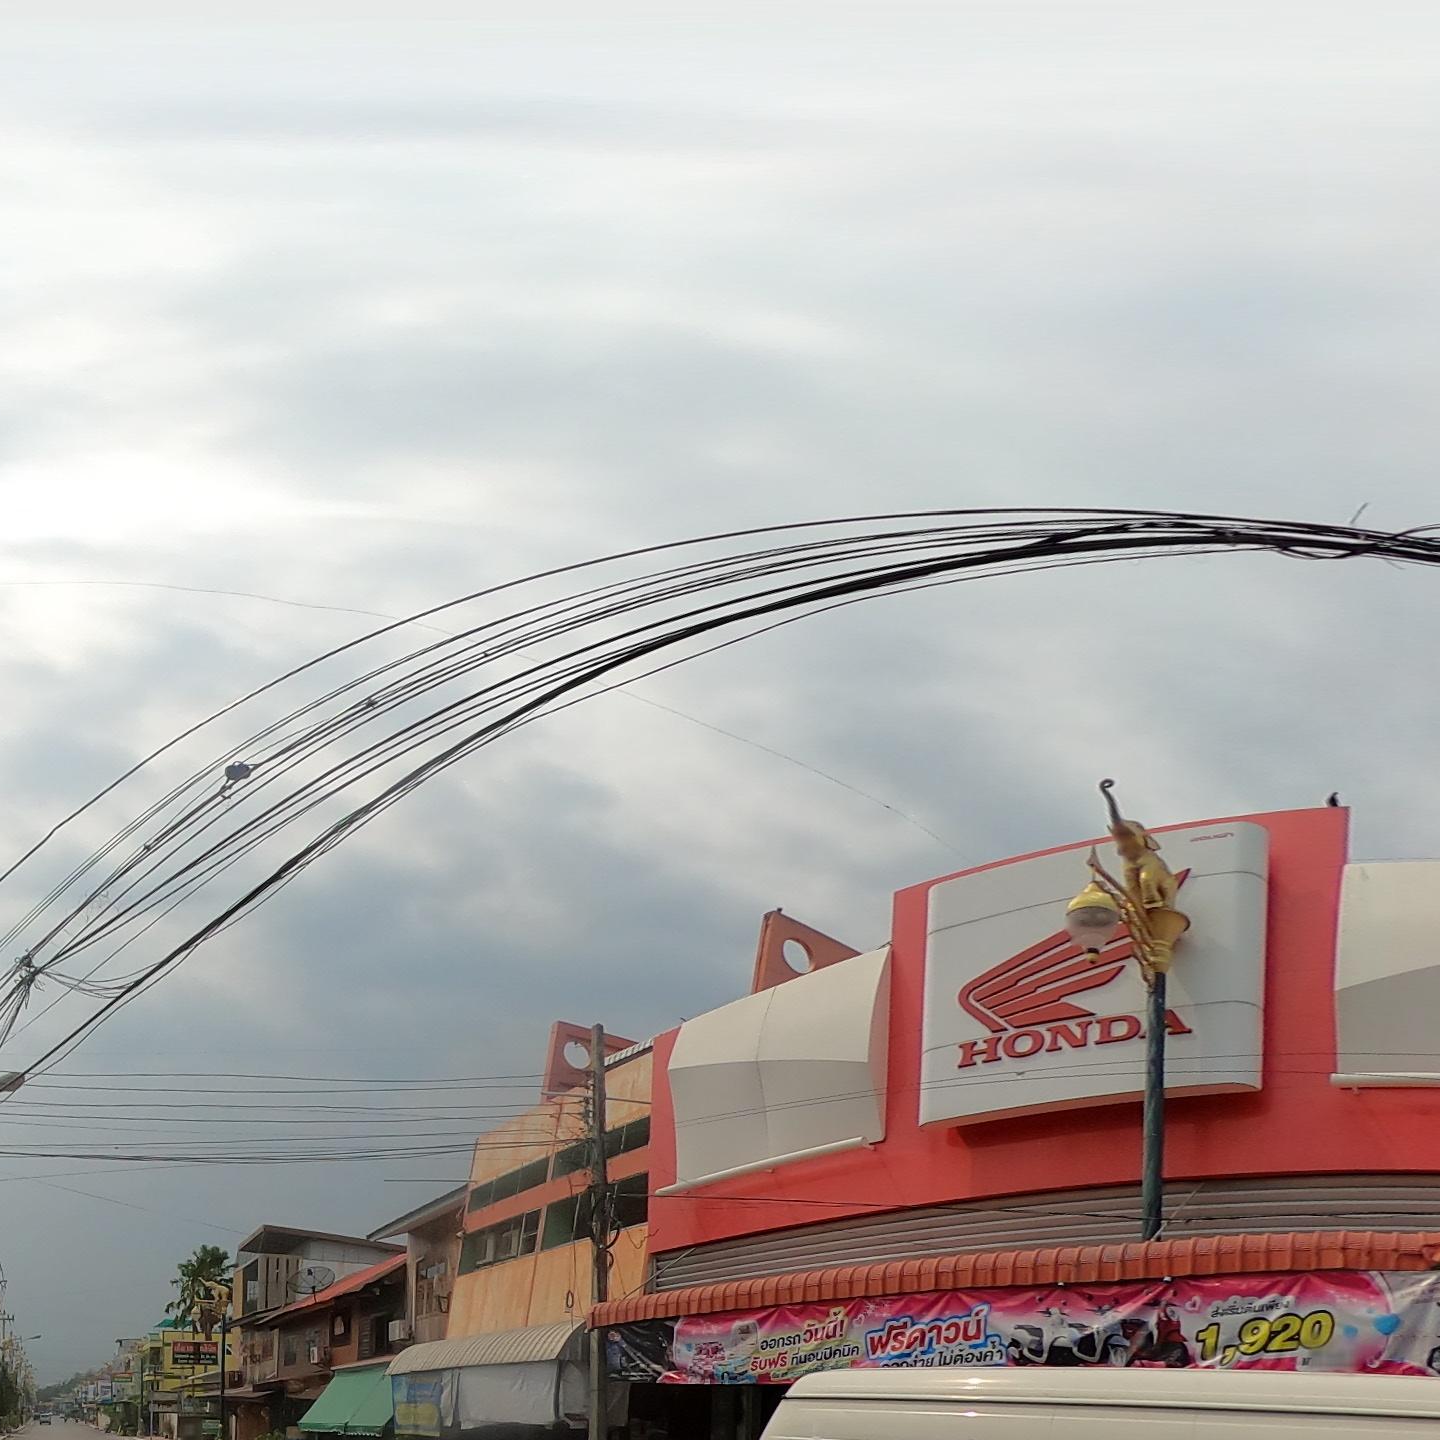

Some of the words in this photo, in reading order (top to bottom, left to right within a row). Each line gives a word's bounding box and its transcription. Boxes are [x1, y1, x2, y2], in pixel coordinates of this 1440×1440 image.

[957, 1008, 1192, 1068] HONDA
[759, 1308, 846, 1351] ออกรถวันนี้!
[868, 1306, 989, 1357] ฟรีดาวน์
[1195, 1310, 1335, 1366] 1,920
[750, 1350, 789, 1372] รับฟรี
